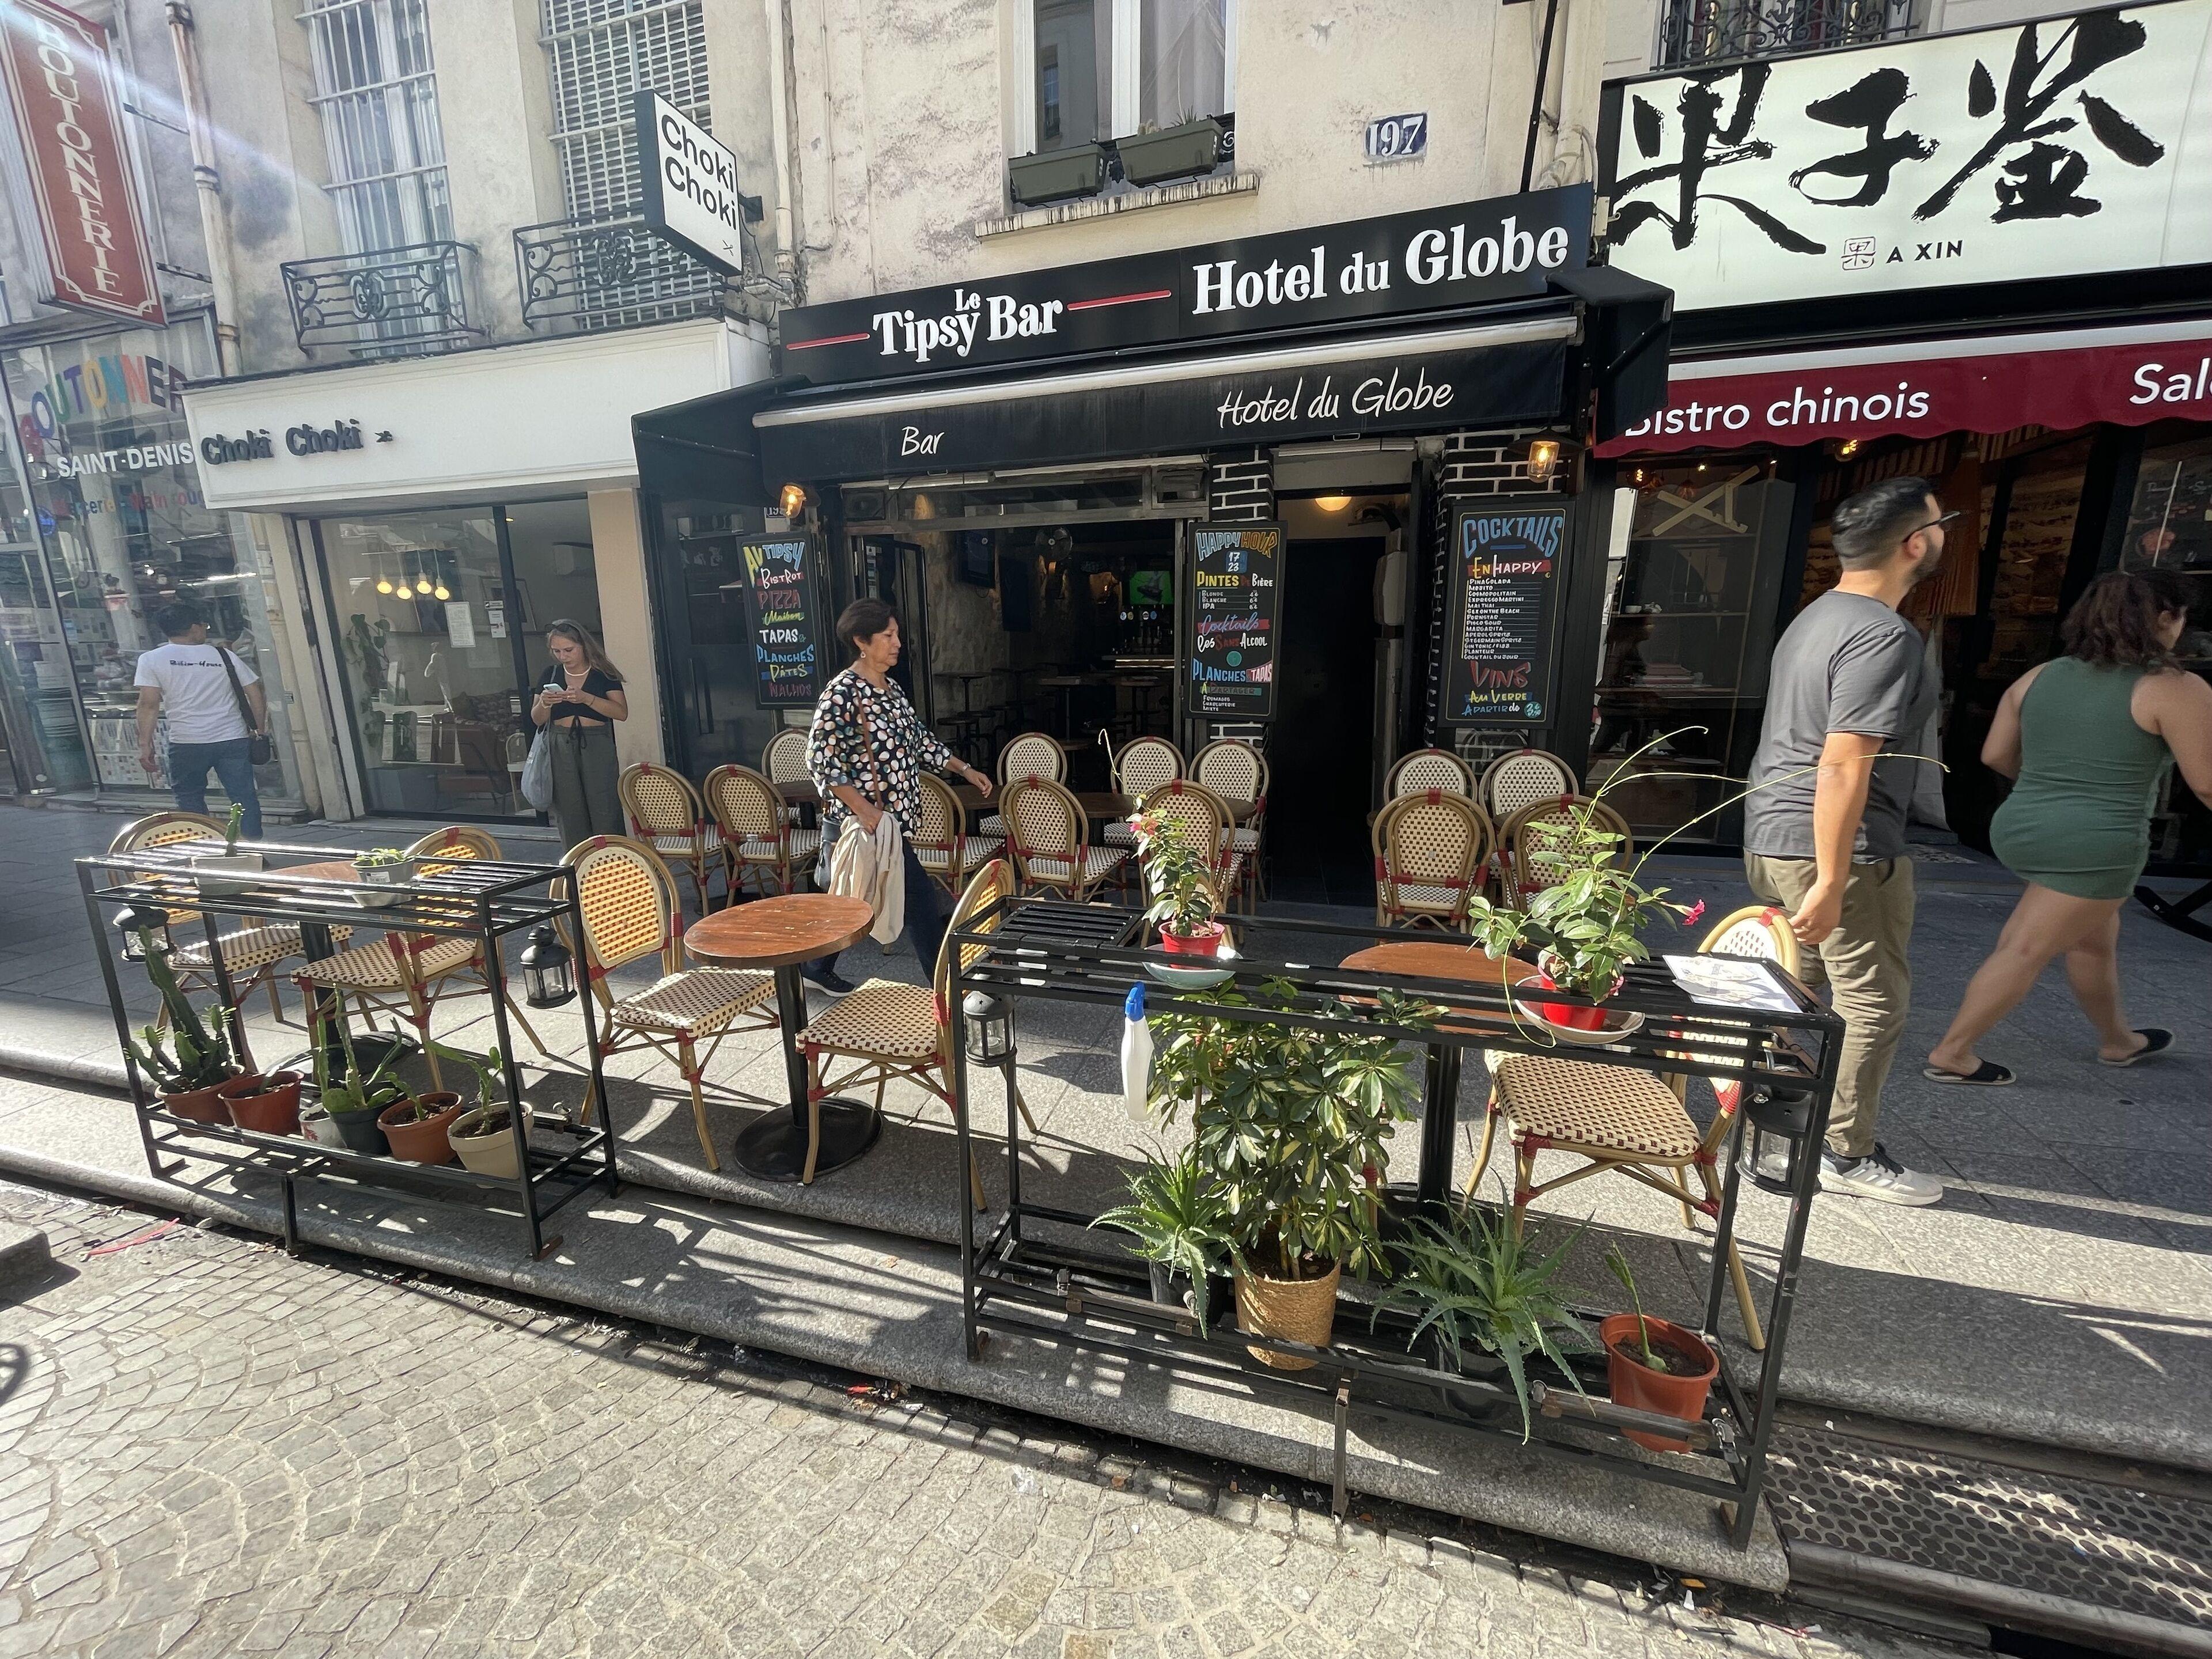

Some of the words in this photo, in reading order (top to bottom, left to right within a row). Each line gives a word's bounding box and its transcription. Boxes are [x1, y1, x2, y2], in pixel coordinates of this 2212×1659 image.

[1369, 115, 1423, 157] 197
[35, 17, 123, 297] BOUTONNERIE
[661, 114, 734, 193] Choki
[665, 156, 736, 230] Choki
[1192, 245, 1327, 315] Hotel
[1340, 251, 1390, 294] du
[1405, 215, 1569, 285] Globe
[1886, 247, 1903, 264] A
[1915, 240, 1963, 261] XIN
[955, 289, 980, 312] Le
[873, 309, 980, 363] Tipsy
[986, 295, 1063, 341] Bar
[2129, 358, 2212, 404] Sal
[1217, 377, 1302, 429] Hotel
[1308, 375, 1338, 419] du
[1351, 366, 1454, 418] Globe
[1766, 381, 1930, 427] chinois
[201, 429, 274, 465] Choki
[286, 418, 363, 456] Choki
[901, 426, 944, 457] Bar
[1196, 532, 1241, 562] HAPPY
[1241, 532, 1277, 558] HOUR
[1463, 517, 1563, 558] COCKTAILS
[762, 542, 805, 571] TIPSY
[1493, 555, 1542, 577] HAPPY
[1197, 571, 1239, 586] PINTES
[757, 590, 801, 609] PIZZA
[759, 628, 798, 643] TAPAS
[1240, 632, 1267, 649] ALCOOL
[756, 643, 814, 662] PLANCHES
[1192, 658, 1245, 681] PLANCHES
[1251, 664, 1271, 681] TAPAS
[1471, 661, 1531, 688] VINS
[1491, 689, 1527, 703] VERRE
